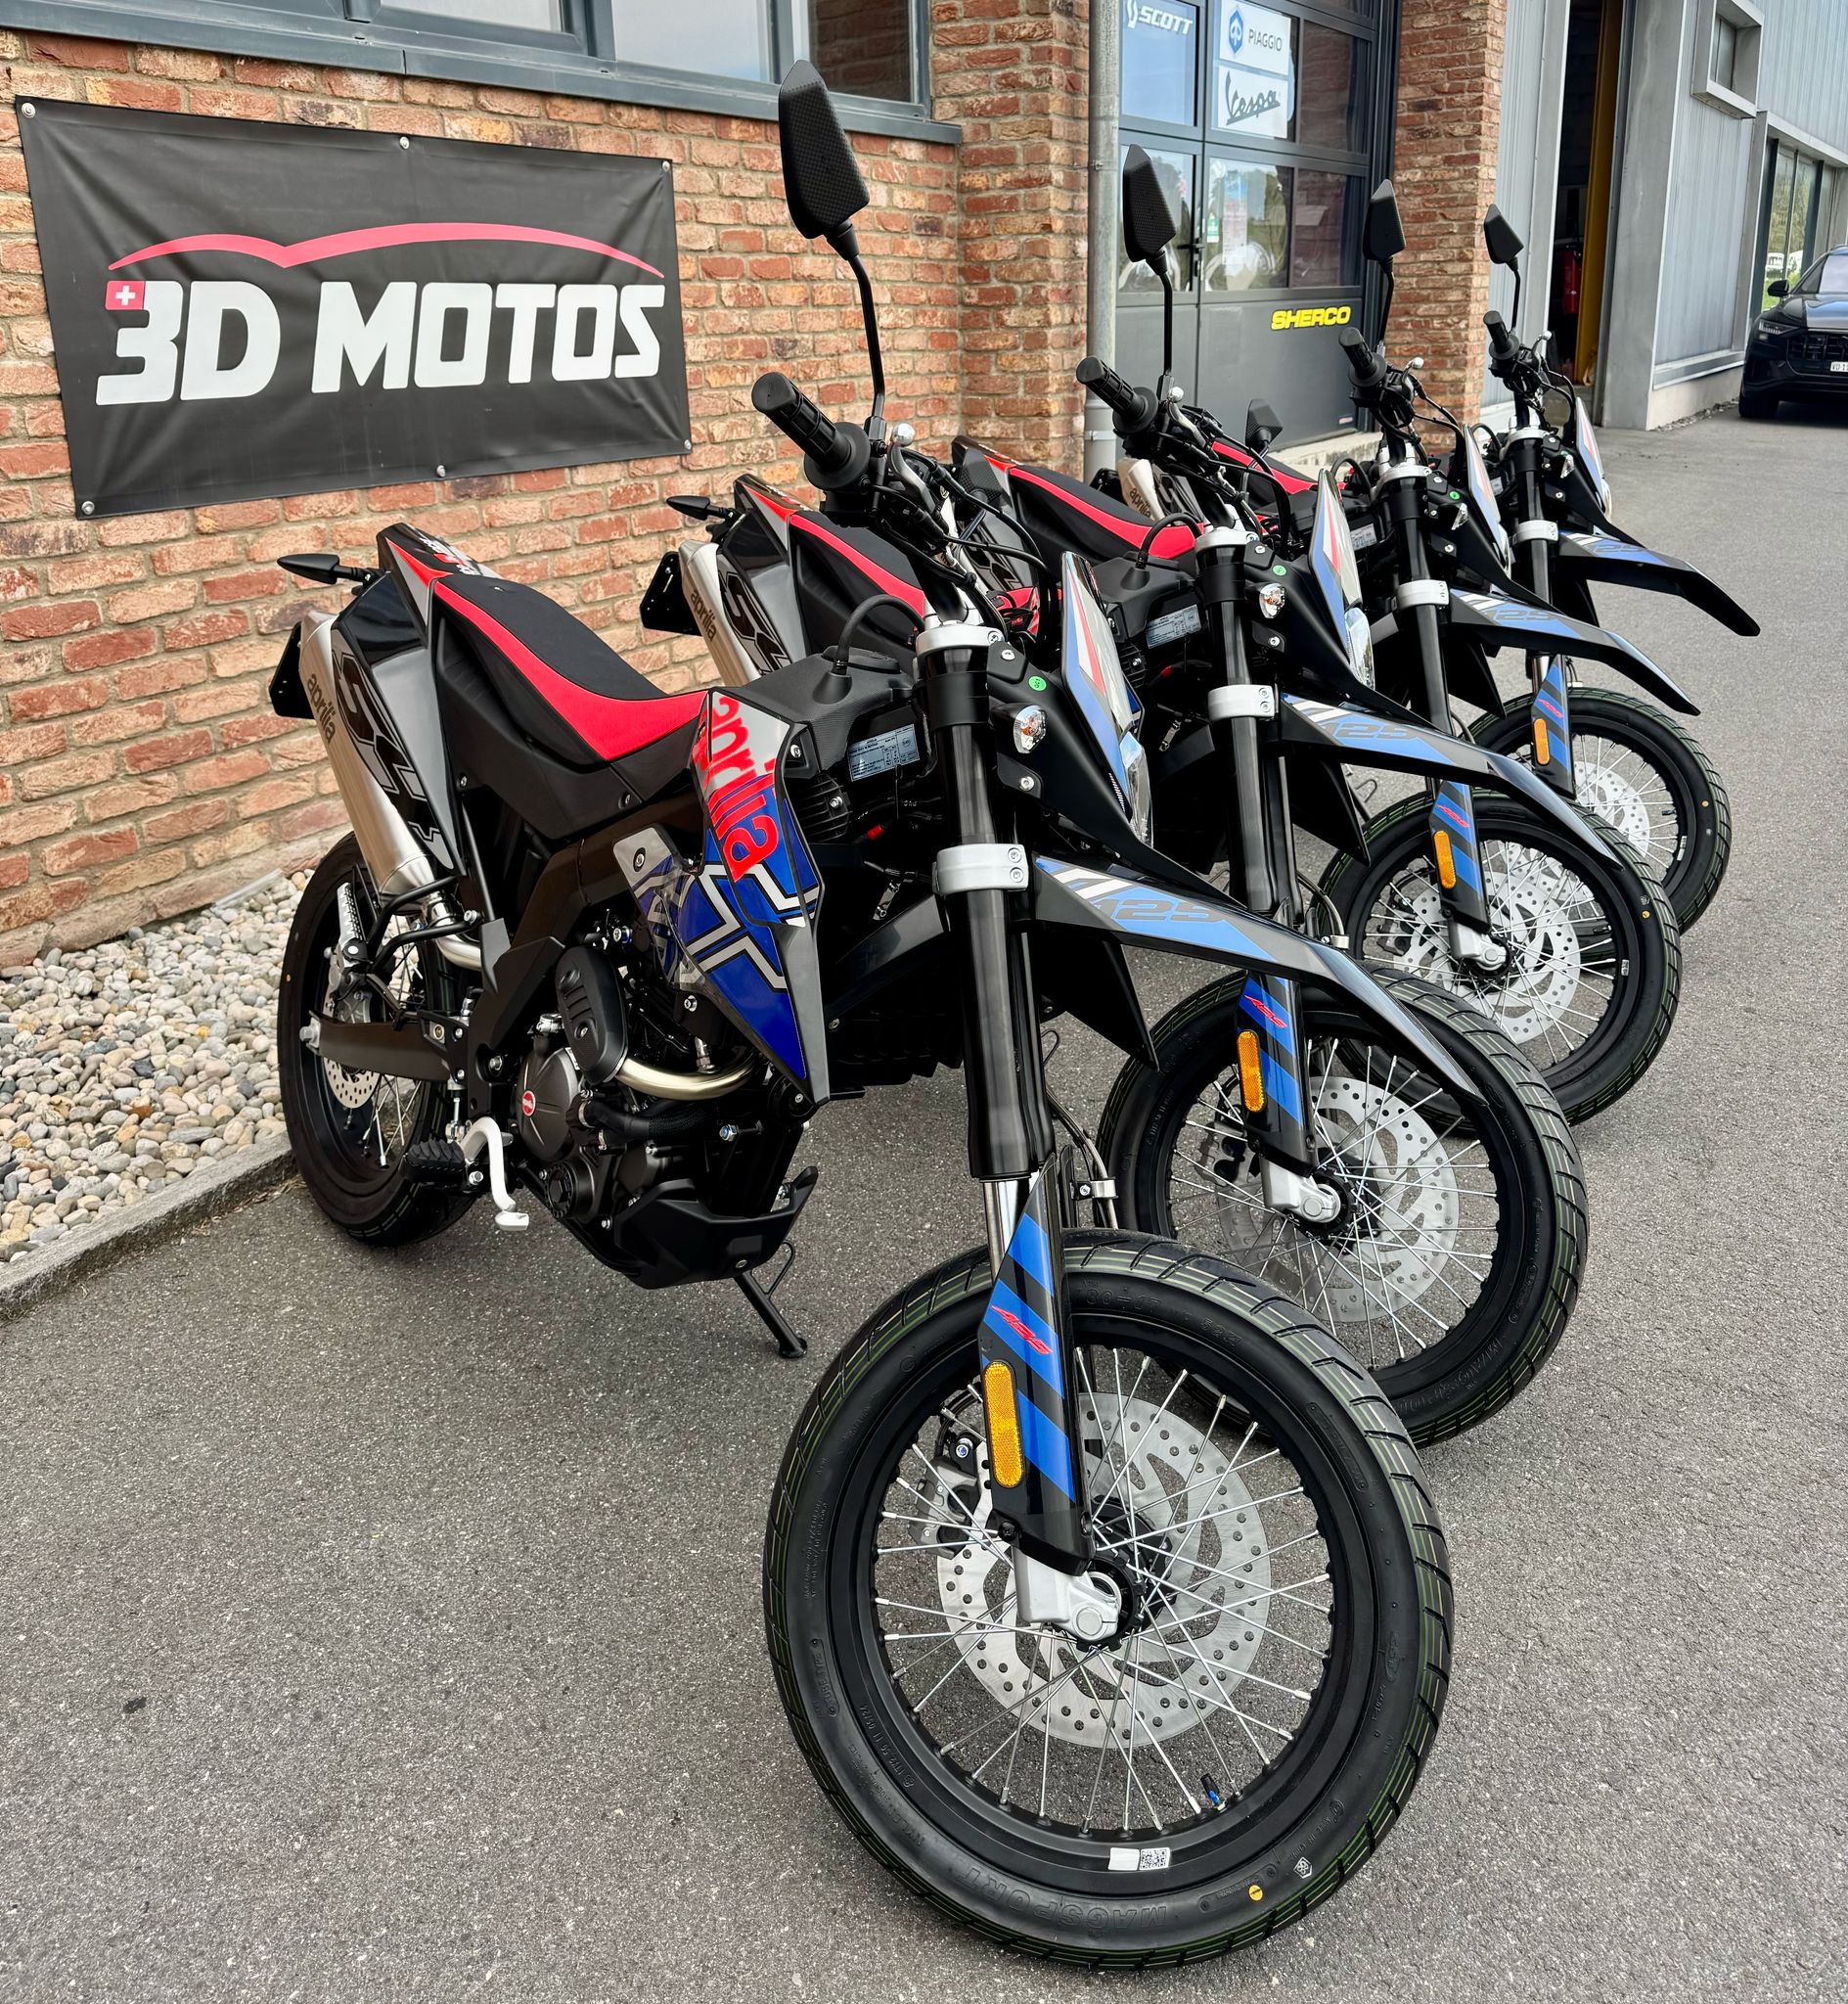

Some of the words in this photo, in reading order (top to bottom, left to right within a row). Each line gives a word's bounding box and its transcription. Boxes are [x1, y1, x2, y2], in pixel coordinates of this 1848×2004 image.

[1139, 6, 1193, 35] SCOTT
[1248, 28, 1283, 52] PIAGGIO
[1225, 70, 1281, 125] Vespa
[96, 280, 281, 405] 3D
[311, 281, 665, 393] MOTOS
[1271, 305, 1351, 331] SHERCO
[1130, 488, 1151, 517] aprilia
[691, 588, 717, 643] aprilia
[307, 673, 337, 745] aprilia
[1322, 722, 1415, 740] 125
[693, 696, 779, 883] aprilia
[1093, 898, 1221, 923] 125
[990, 1304, 1054, 1355] ABS
[954, 1866, 1168, 1929] MAGSPORT
